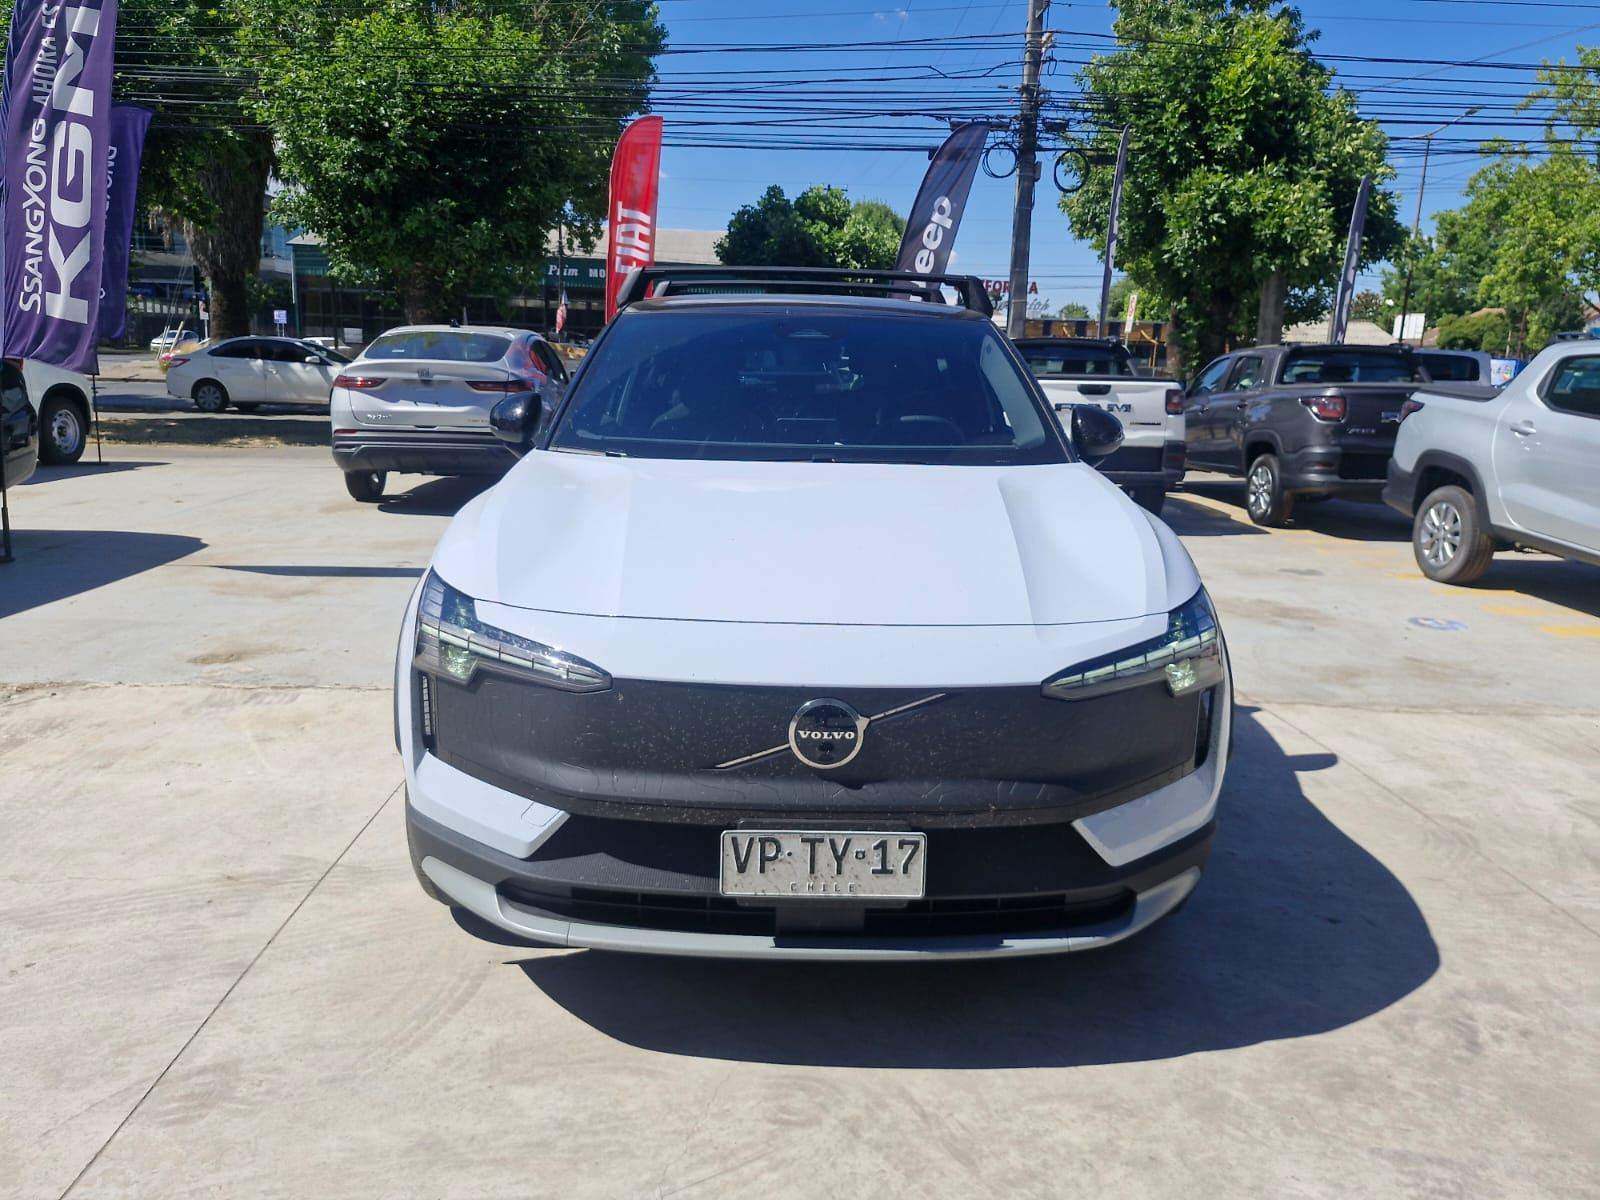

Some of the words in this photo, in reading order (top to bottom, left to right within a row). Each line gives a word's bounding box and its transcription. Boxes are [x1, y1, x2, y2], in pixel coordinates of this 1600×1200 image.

[41, 2, 60, 29] ES
[32, 37, 58, 106] AHORA
[46, 6, 101, 325] KGM
[19, 118, 48, 315] SSANGYONG
[615, 201, 651, 273] FIAT
[1054, 403, 1132, 413] RM
[798, 730, 856, 740] VOLVO
[790, 881, 856, 893] CHILE
